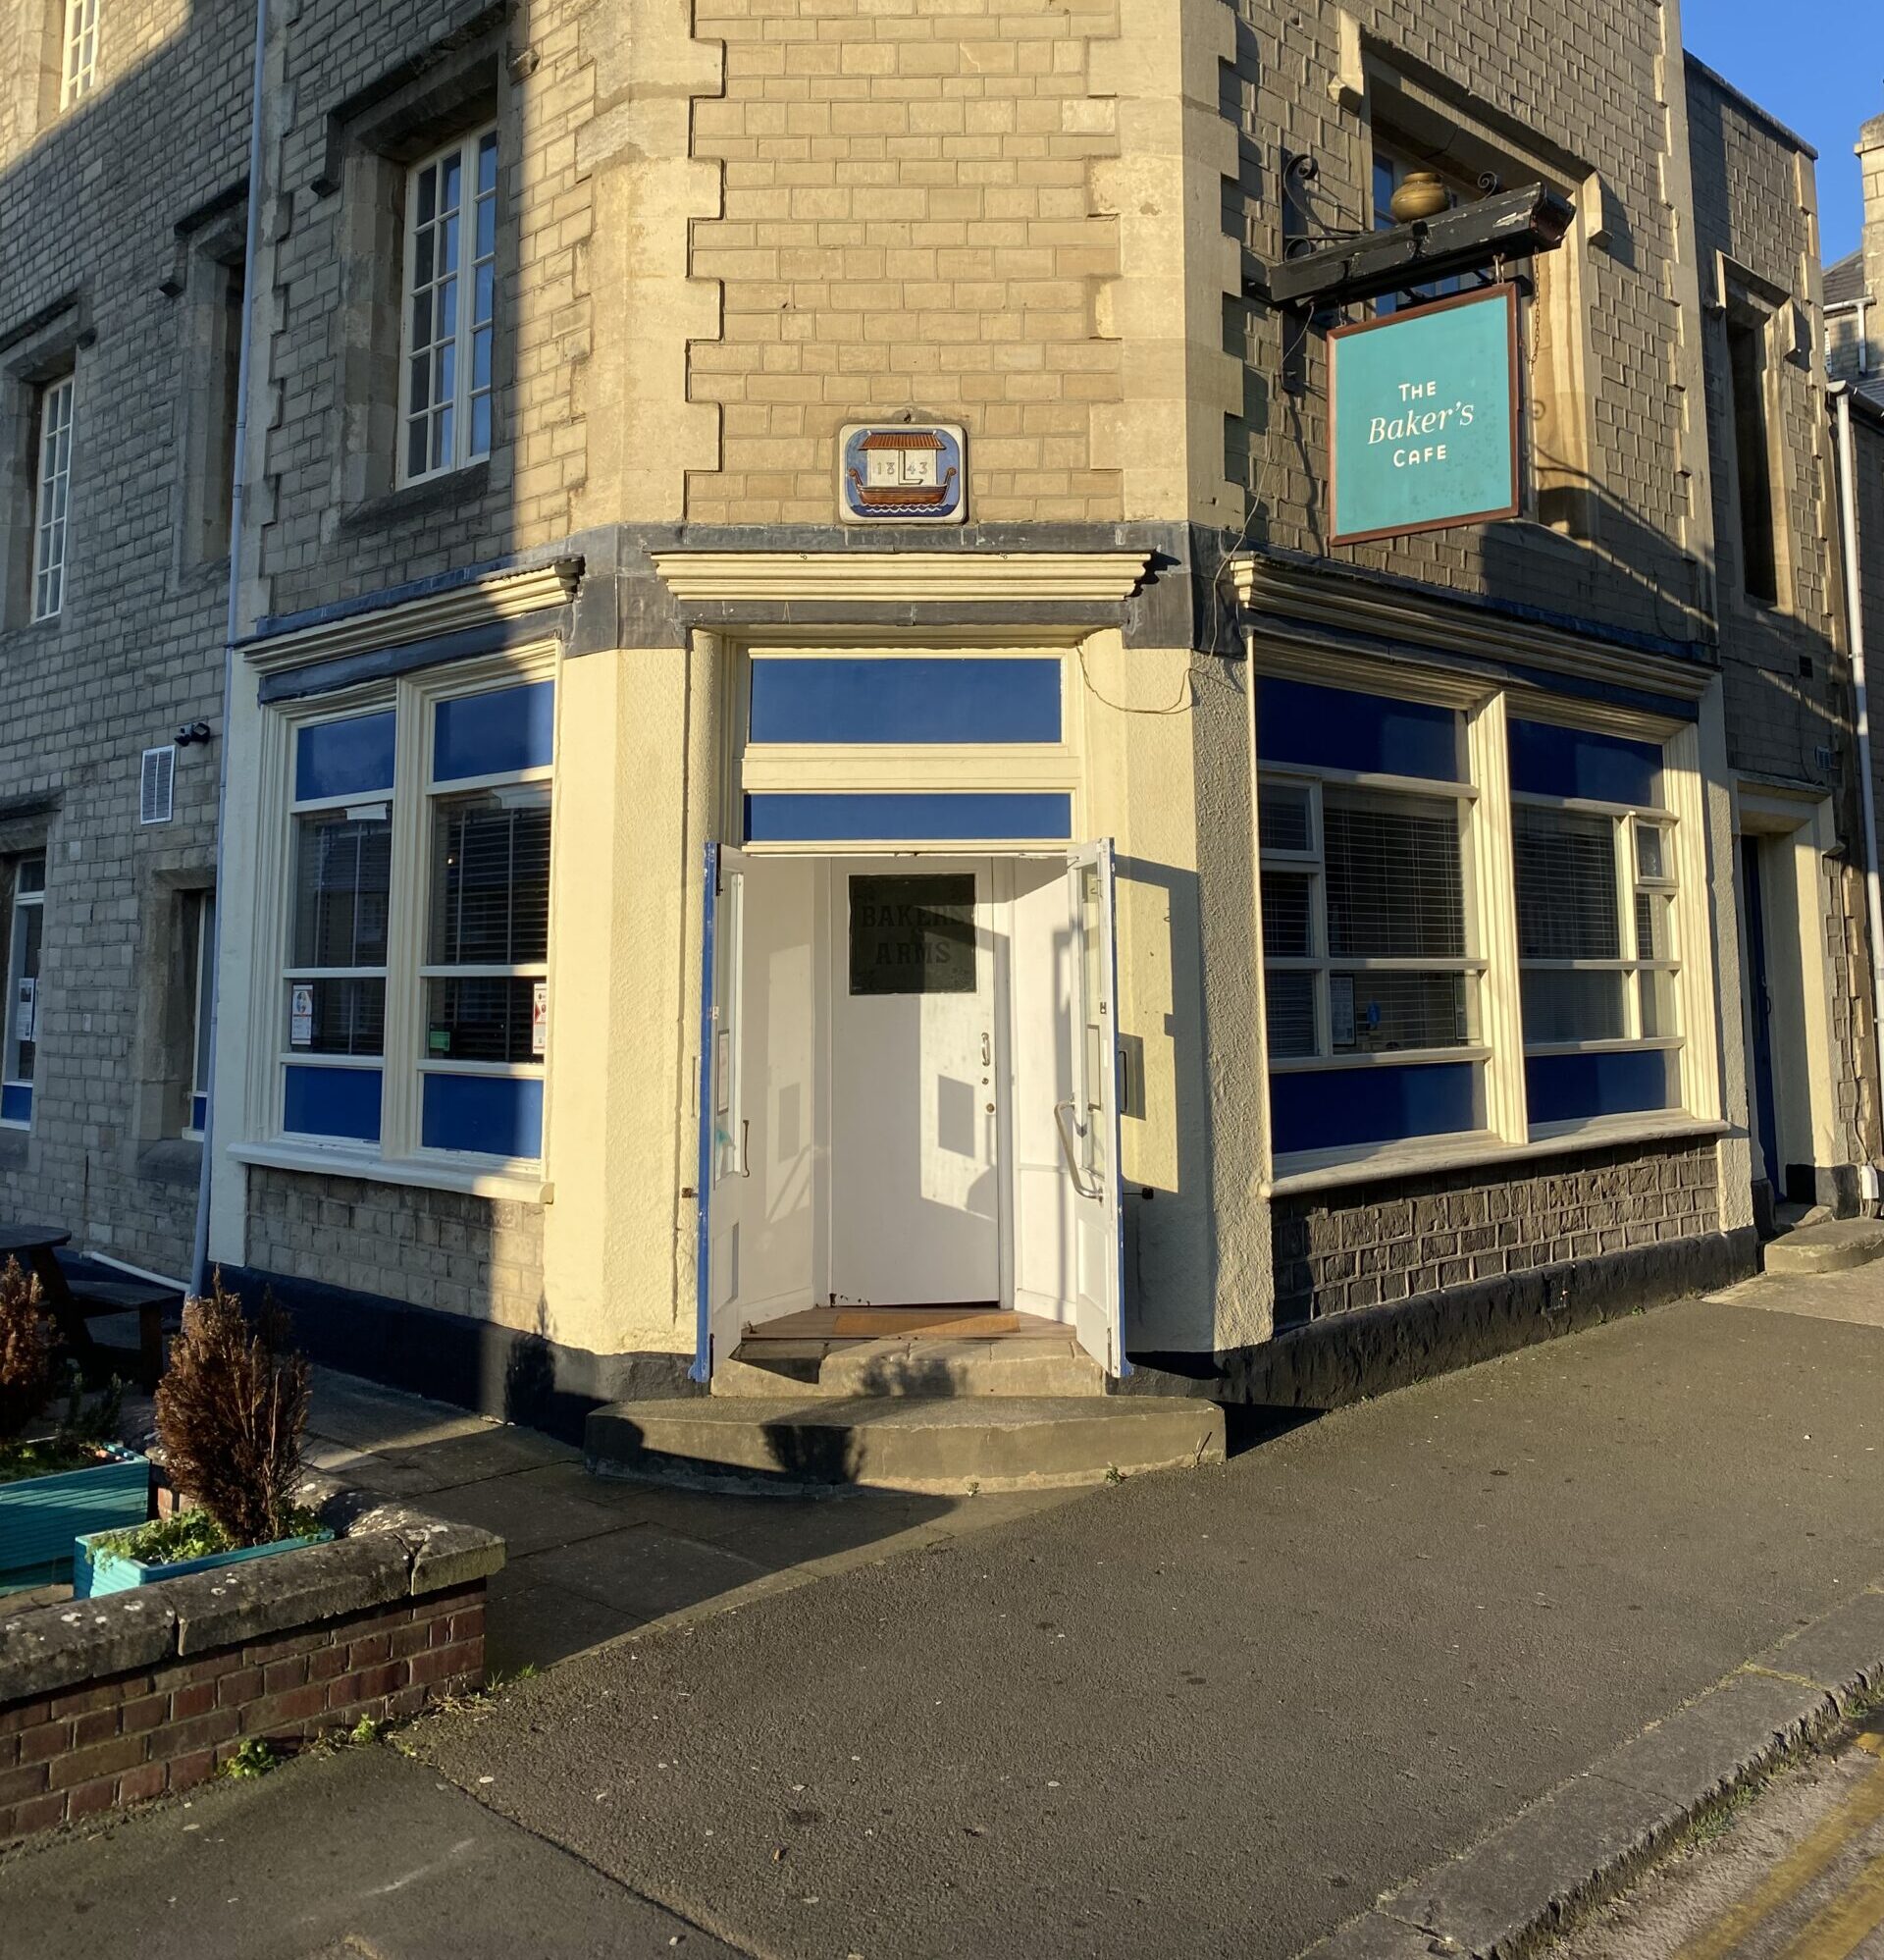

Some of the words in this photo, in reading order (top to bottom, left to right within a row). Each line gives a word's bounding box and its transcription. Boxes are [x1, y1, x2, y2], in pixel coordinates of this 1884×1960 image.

[1398, 381, 1437, 401] THE
[1368, 401, 1475, 445] Baker's
[1393, 445, 1446, 467] CAFE
[875, 941, 951, 964] ARMS
